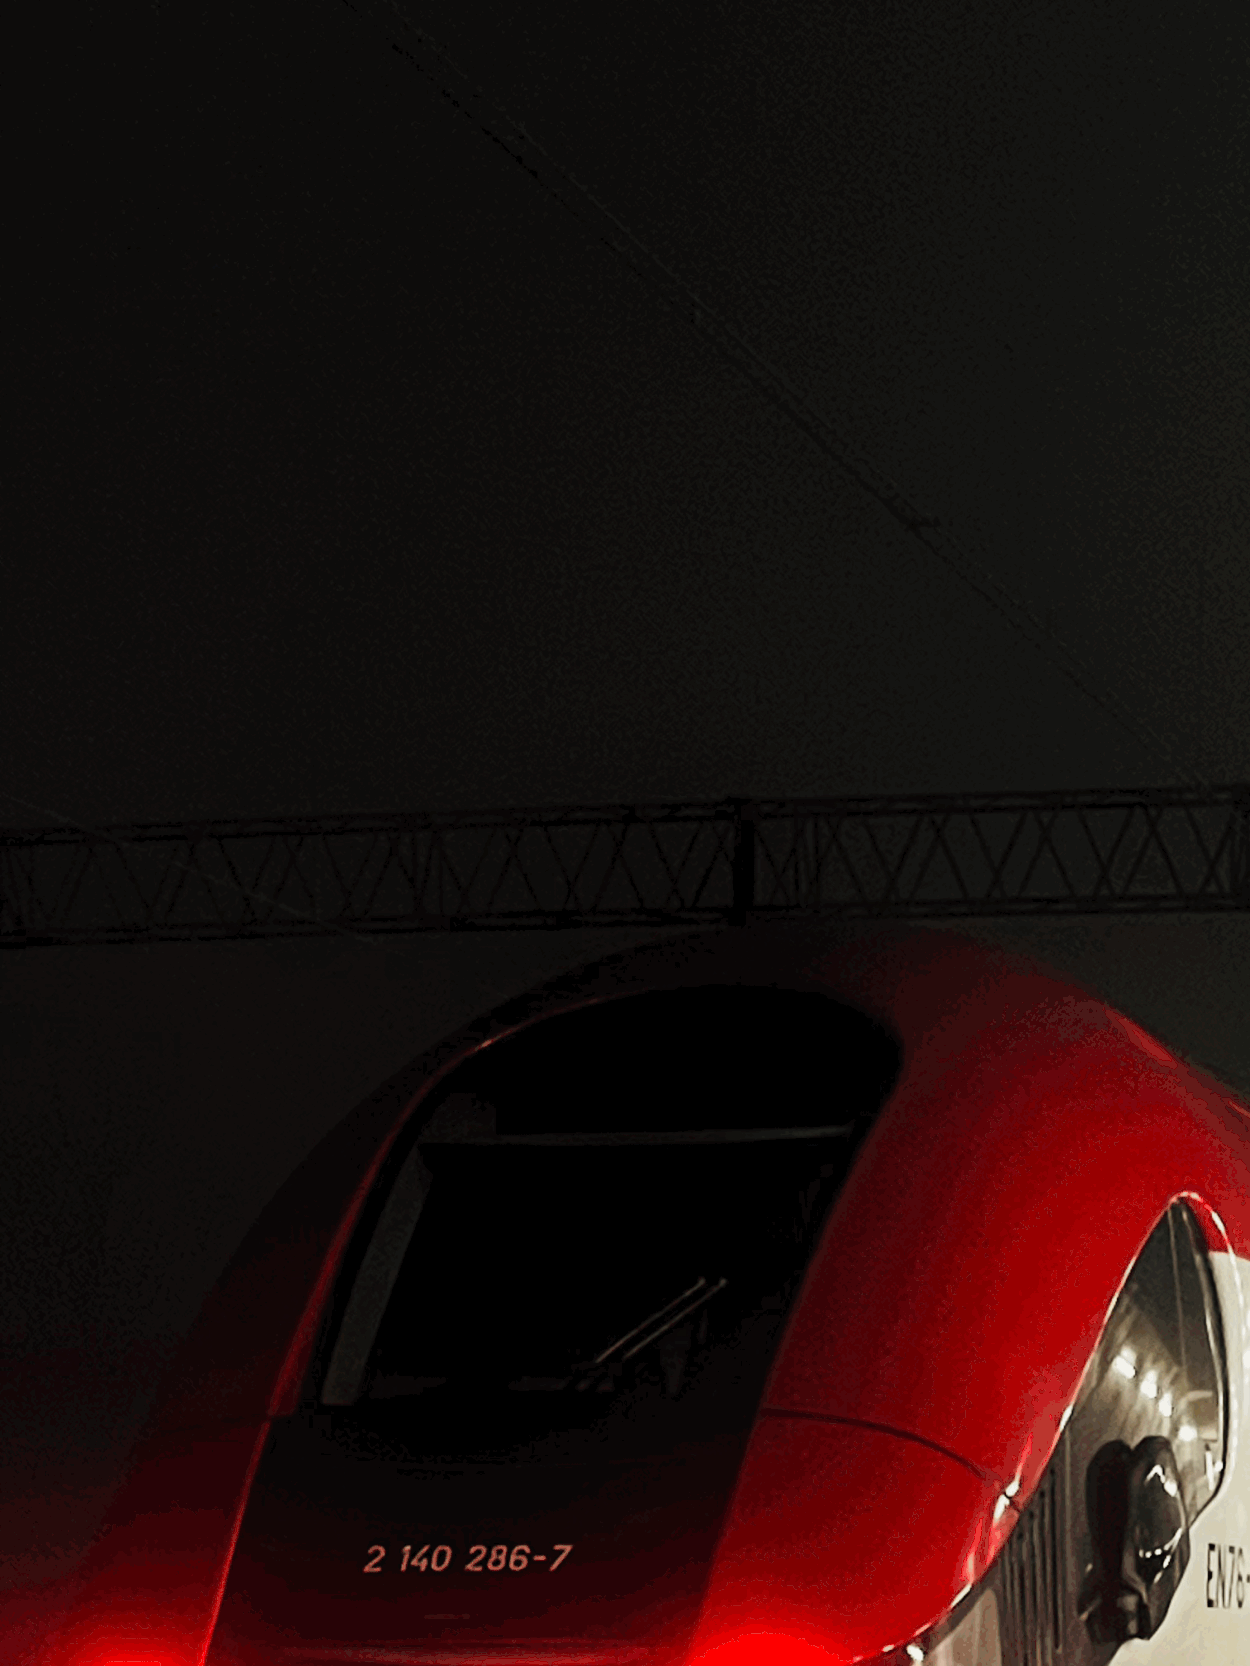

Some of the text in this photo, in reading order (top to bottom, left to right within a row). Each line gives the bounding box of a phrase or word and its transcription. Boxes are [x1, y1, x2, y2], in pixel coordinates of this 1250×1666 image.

[363, 1544, 574, 1573] 2 140 286-7
